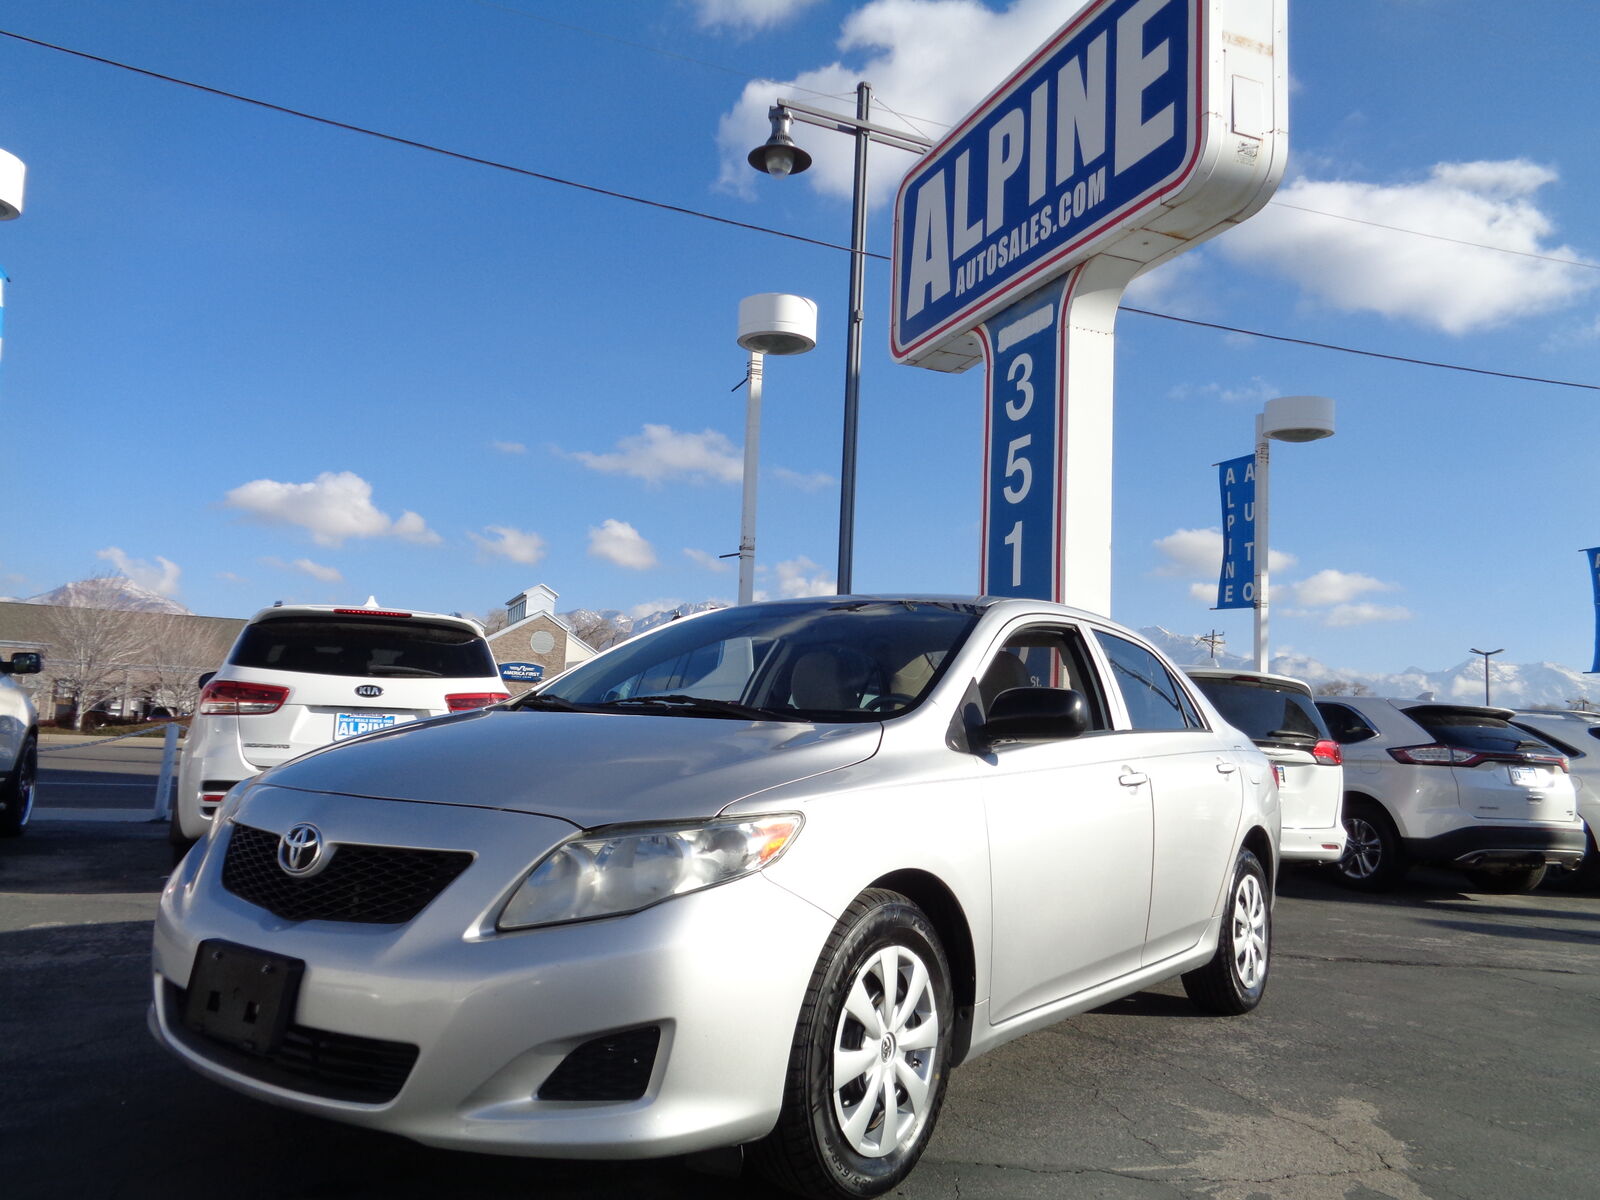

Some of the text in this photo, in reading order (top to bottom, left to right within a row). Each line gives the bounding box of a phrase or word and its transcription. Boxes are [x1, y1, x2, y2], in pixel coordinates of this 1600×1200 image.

[906, 0, 1175, 320] ALPINE
[955, 167, 1106, 298] AUTOSALES.COM
[1224, 467, 1236, 603] ALPINE
[1242, 463, 1255, 602] AUTO
[338, 722, 394, 736] ALPI
[359, 686, 380, 695] KIA
[1030, 675, 1042, 687] St.
